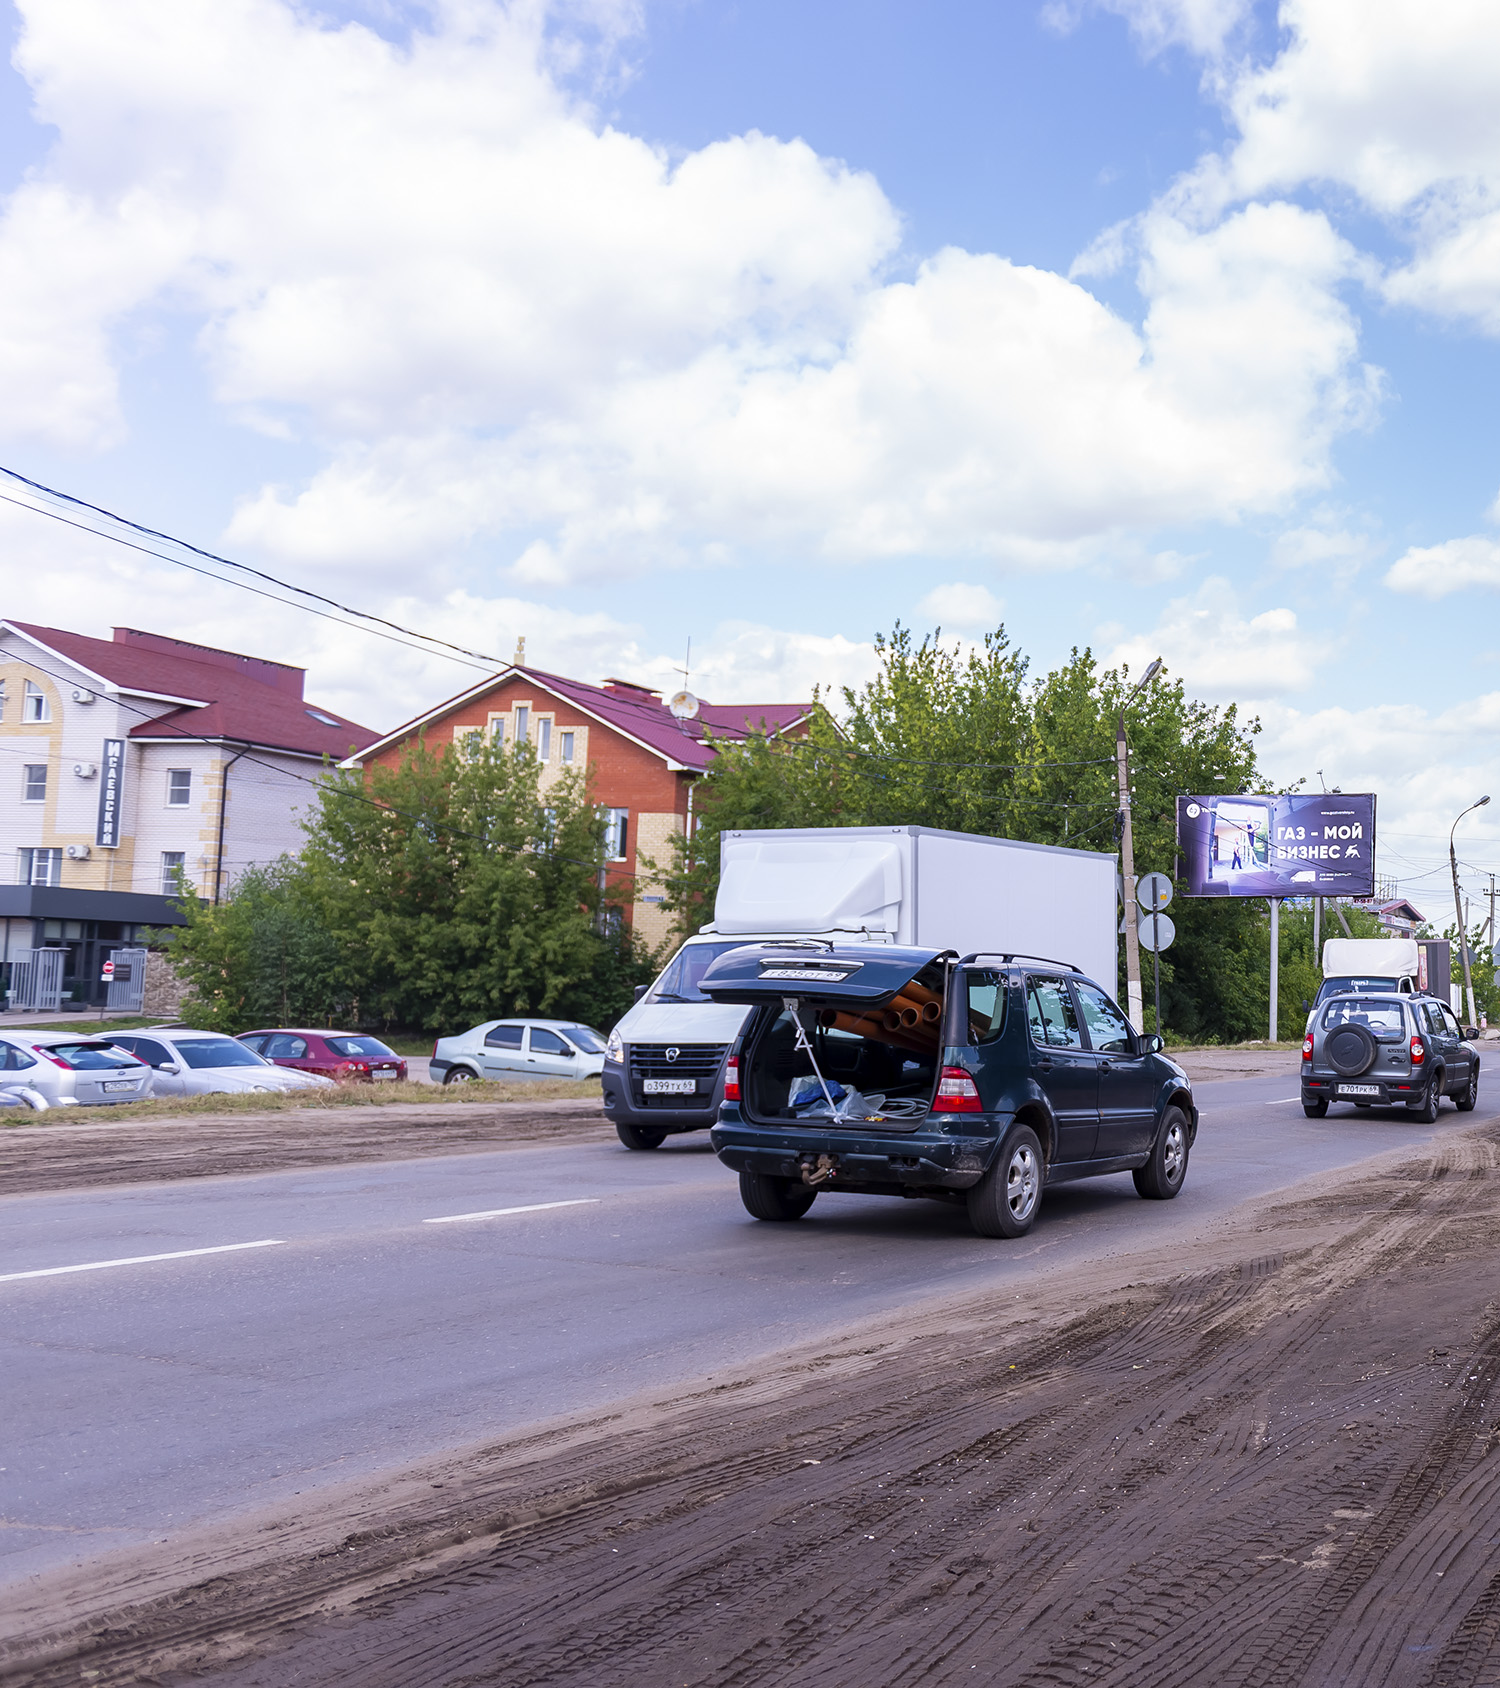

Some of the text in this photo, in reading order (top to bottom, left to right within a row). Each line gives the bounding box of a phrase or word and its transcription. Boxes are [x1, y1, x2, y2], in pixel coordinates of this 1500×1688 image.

[102, 741, 120, 845] ИСАЕВСКИЙ
[1277, 826, 1306, 841] ГАЗ
[1324, 822, 1363, 840] МОЙ
[1276, 844, 1341, 860] БИЗНЕС
